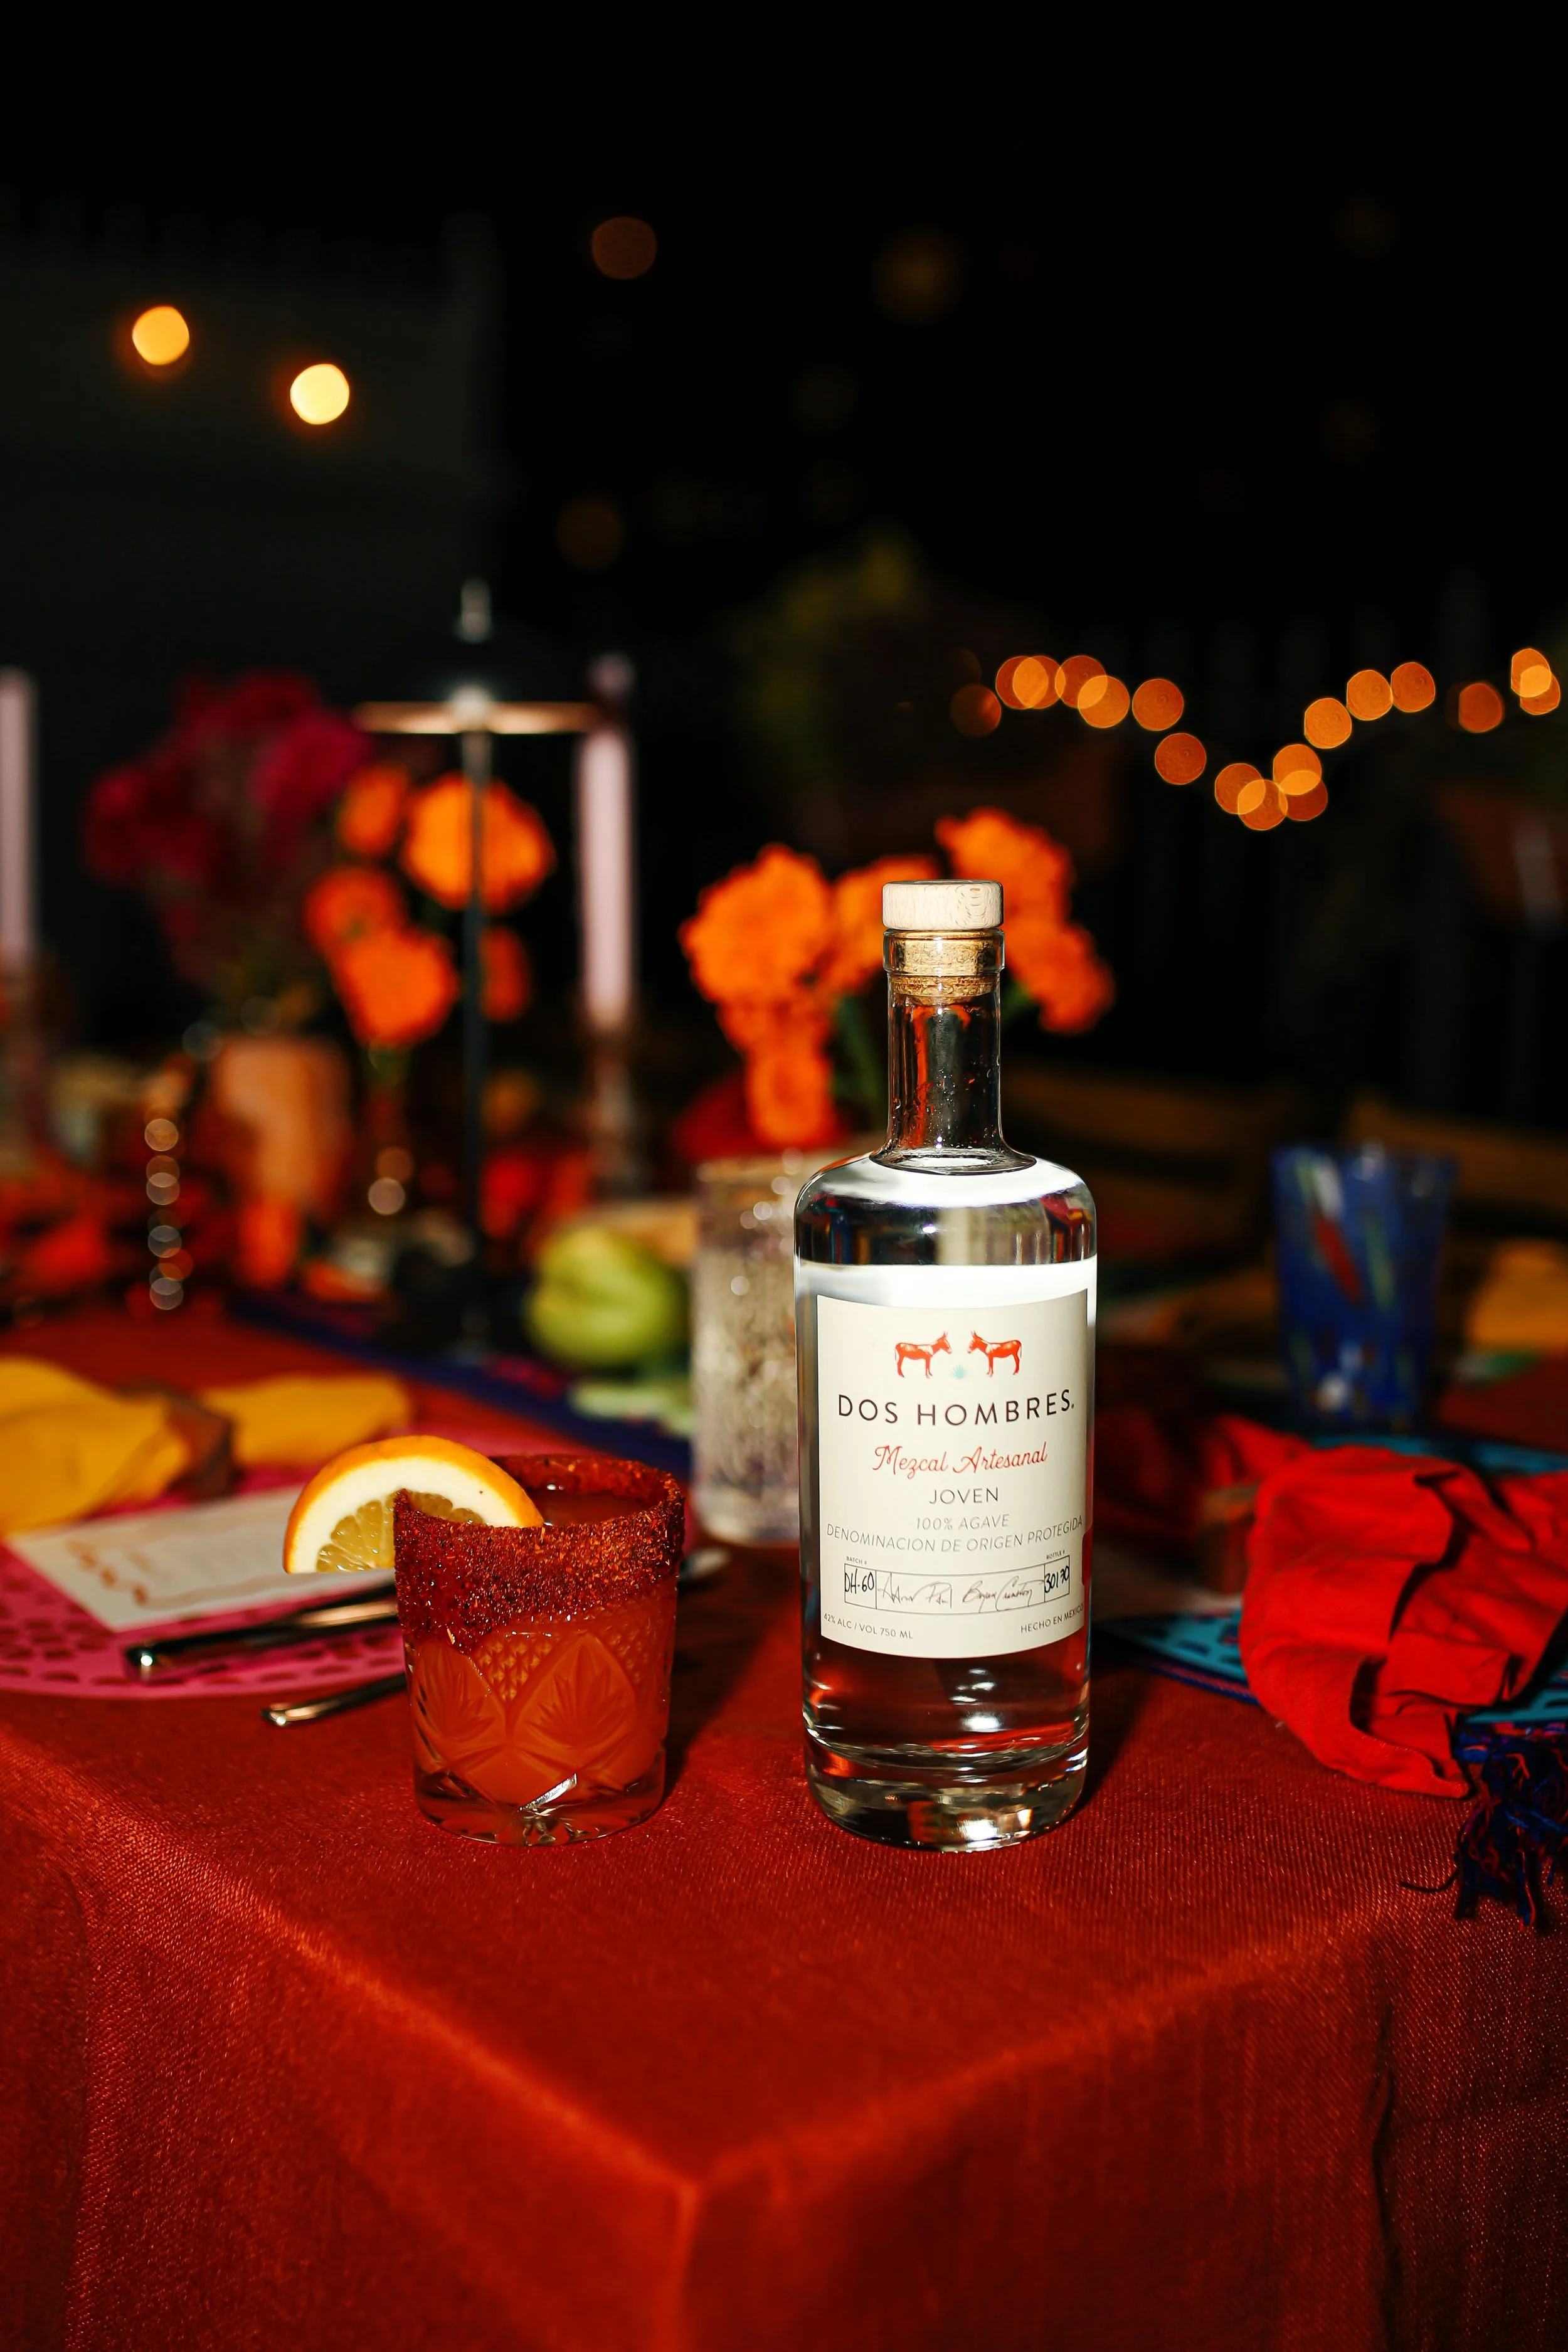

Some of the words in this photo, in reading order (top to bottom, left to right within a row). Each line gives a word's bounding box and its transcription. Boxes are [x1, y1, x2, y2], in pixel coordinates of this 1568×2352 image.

[839, 1394, 898, 1424] DOS
[872, 1445, 948, 1479] Mezcal
[953, 1442, 1048, 1473] Artesanal
[929, 1487, 999, 1505] JOVEN
[827, 1523, 936, 1552] DENOMINACION
[941, 1539, 961, 1552] DE
[967, 1533, 1023, 1552] ORIGEN
[1027, 1515, 1083, 1544] PROTEGIDA
[916, 1516, 953, 1531] 100%
[958, 1513, 1010, 1530] AGAVE
[846, 1556, 863, 1565] BATCH
[844, 1568, 875, 1594] DH-60
[824, 1613, 836, 1624] 42%
[837, 1618, 852, 1629] ALC
[859, 1624, 877, 1634] VOL
[880, 1628, 896, 1637] 750
[899, 1631, 913, 1639] ML
[1020, 1619, 1051, 1633] HECHO
[1053, 1614, 1063, 1625] EN
[1064, 1603, 1084, 1620] MEXICO
